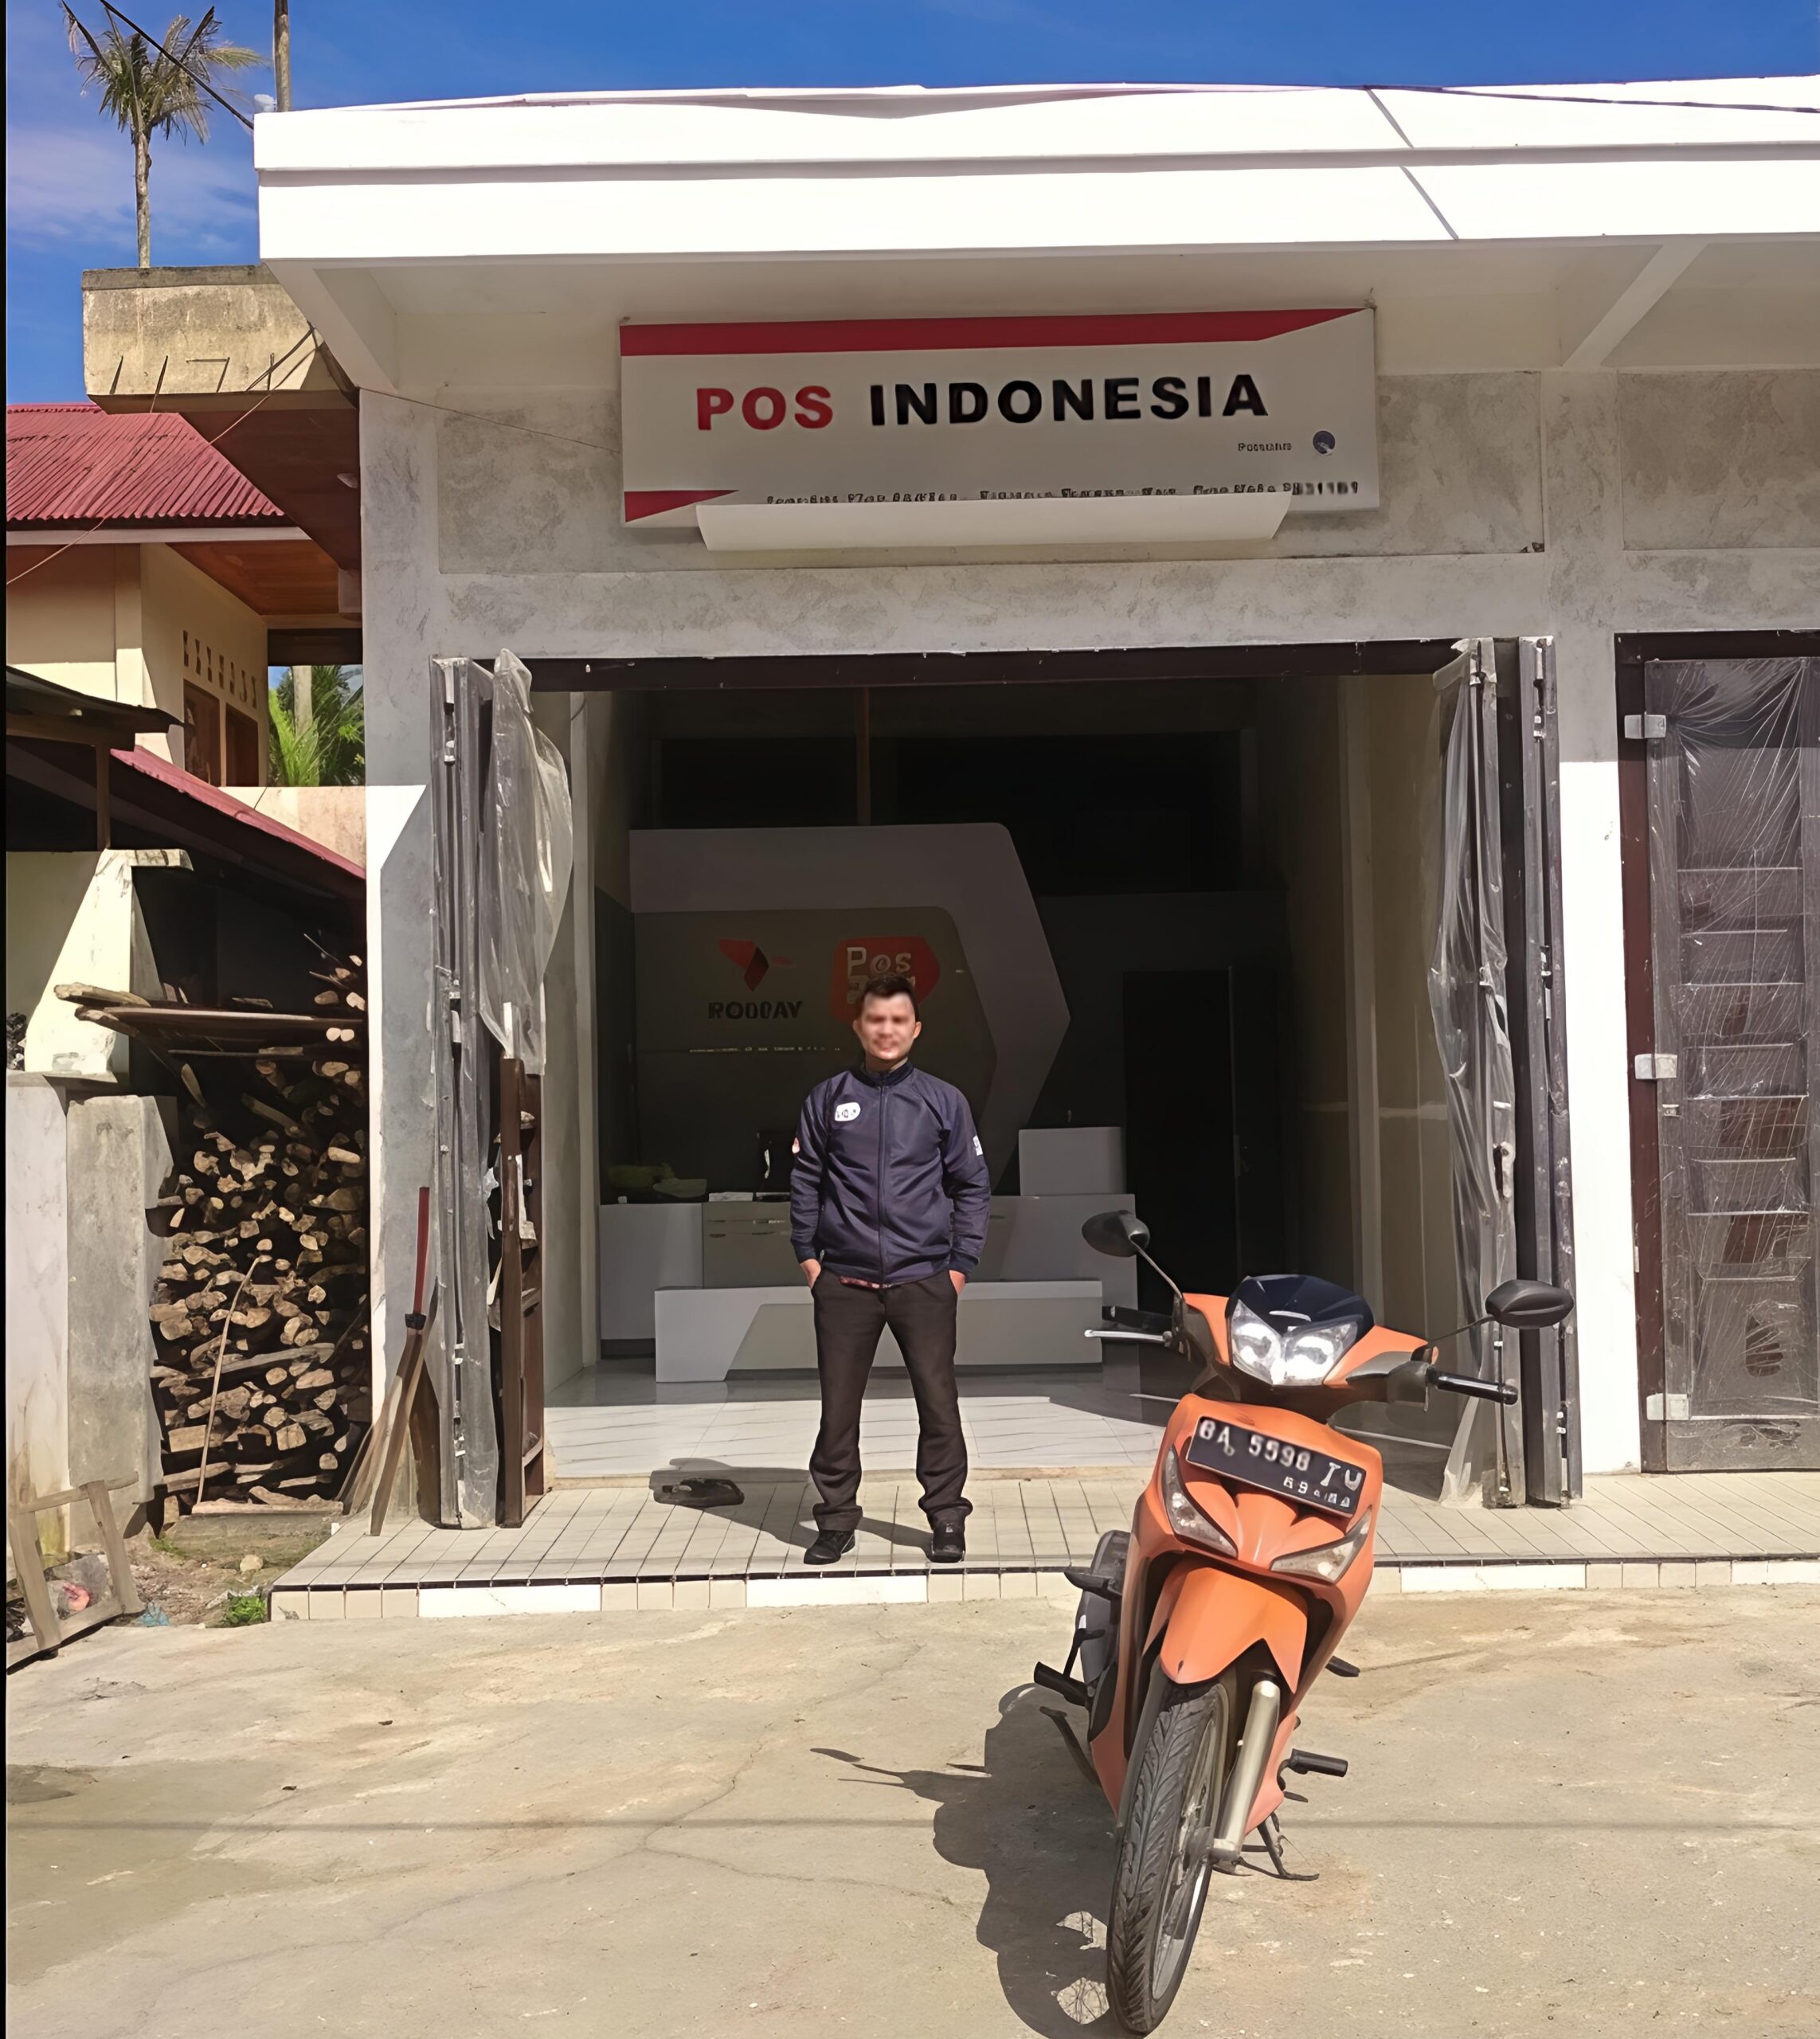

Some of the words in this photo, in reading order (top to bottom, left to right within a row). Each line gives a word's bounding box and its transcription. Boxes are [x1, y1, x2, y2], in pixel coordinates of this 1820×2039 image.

[696, 385, 834, 431] POS
[870, 374, 1269, 425] INDONESIA
[847, 947, 911, 976] Pos
